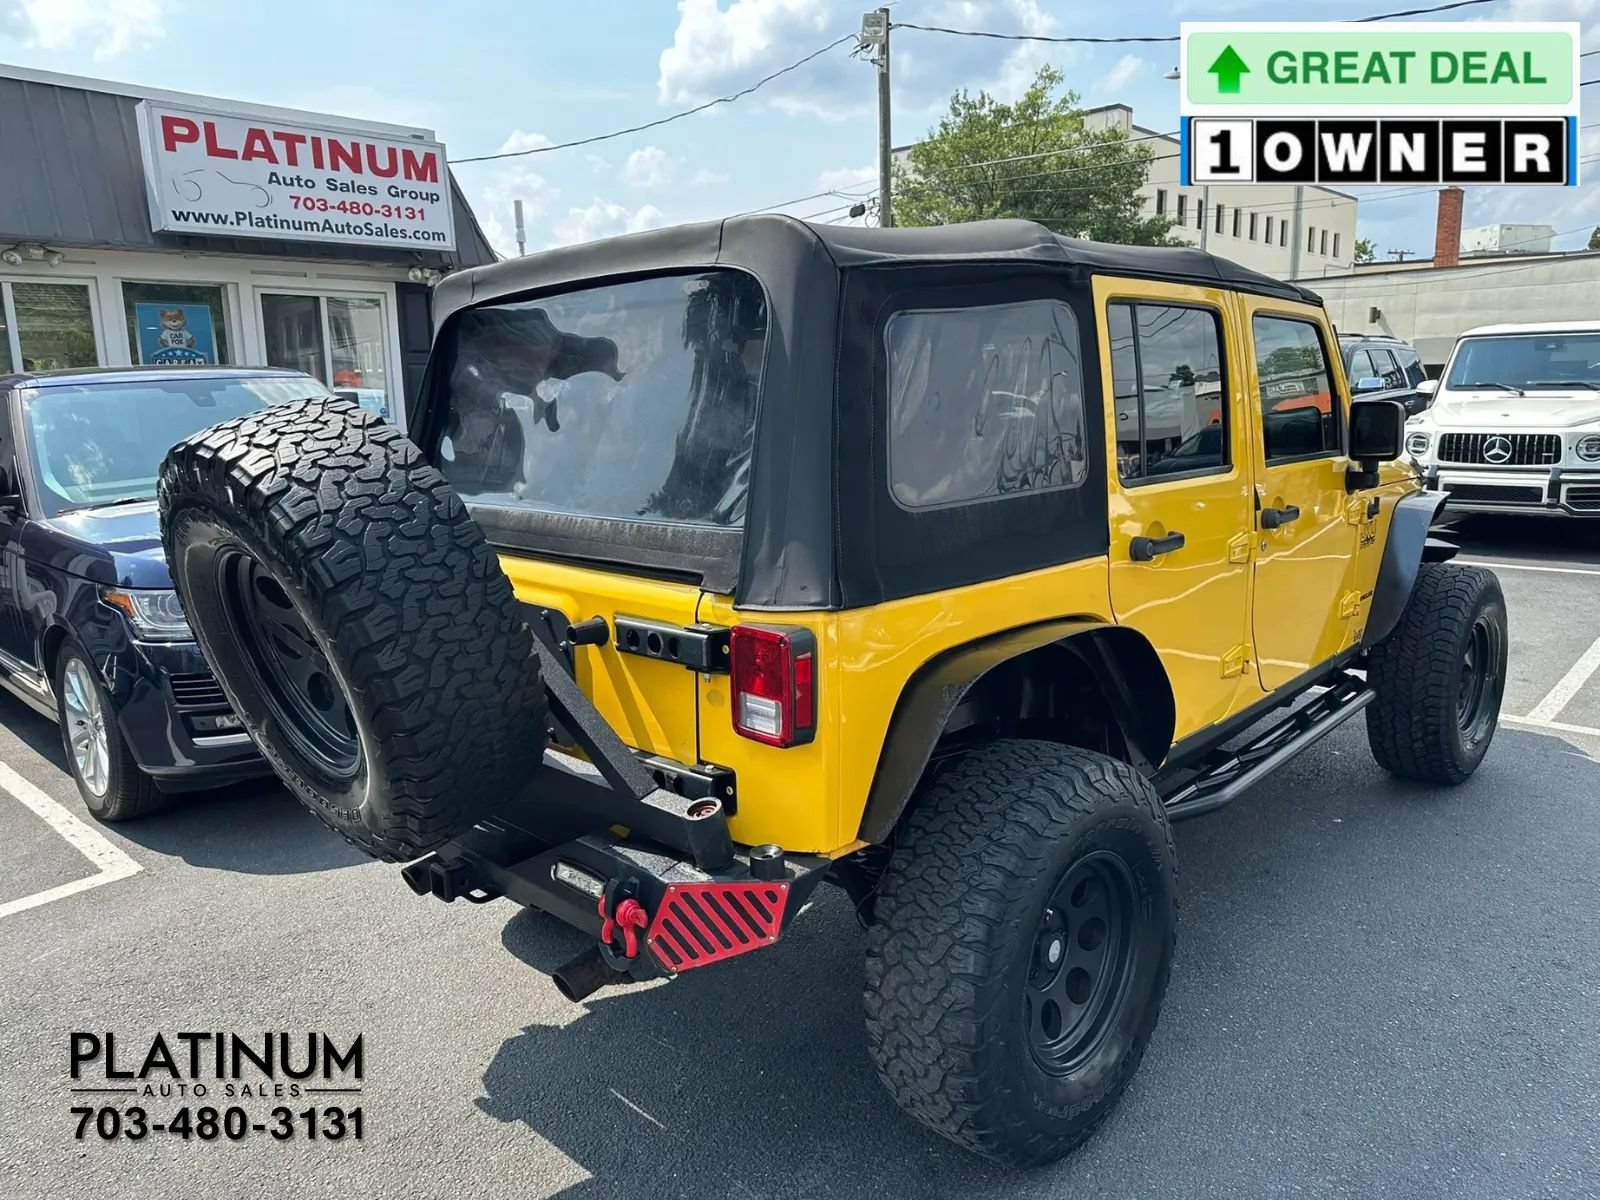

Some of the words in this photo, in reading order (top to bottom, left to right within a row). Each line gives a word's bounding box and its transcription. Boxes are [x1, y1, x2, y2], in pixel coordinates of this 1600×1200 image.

[161, 115, 438, 183] PLATINUM
[268, 171, 316, 189] Auto
[326, 178, 378, 195] Sales
[387, 185, 440, 204] Group
[289, 195, 425, 221] 703-480-3131
[171, 209, 446, 242] www.PlatinumAutoSales.com
